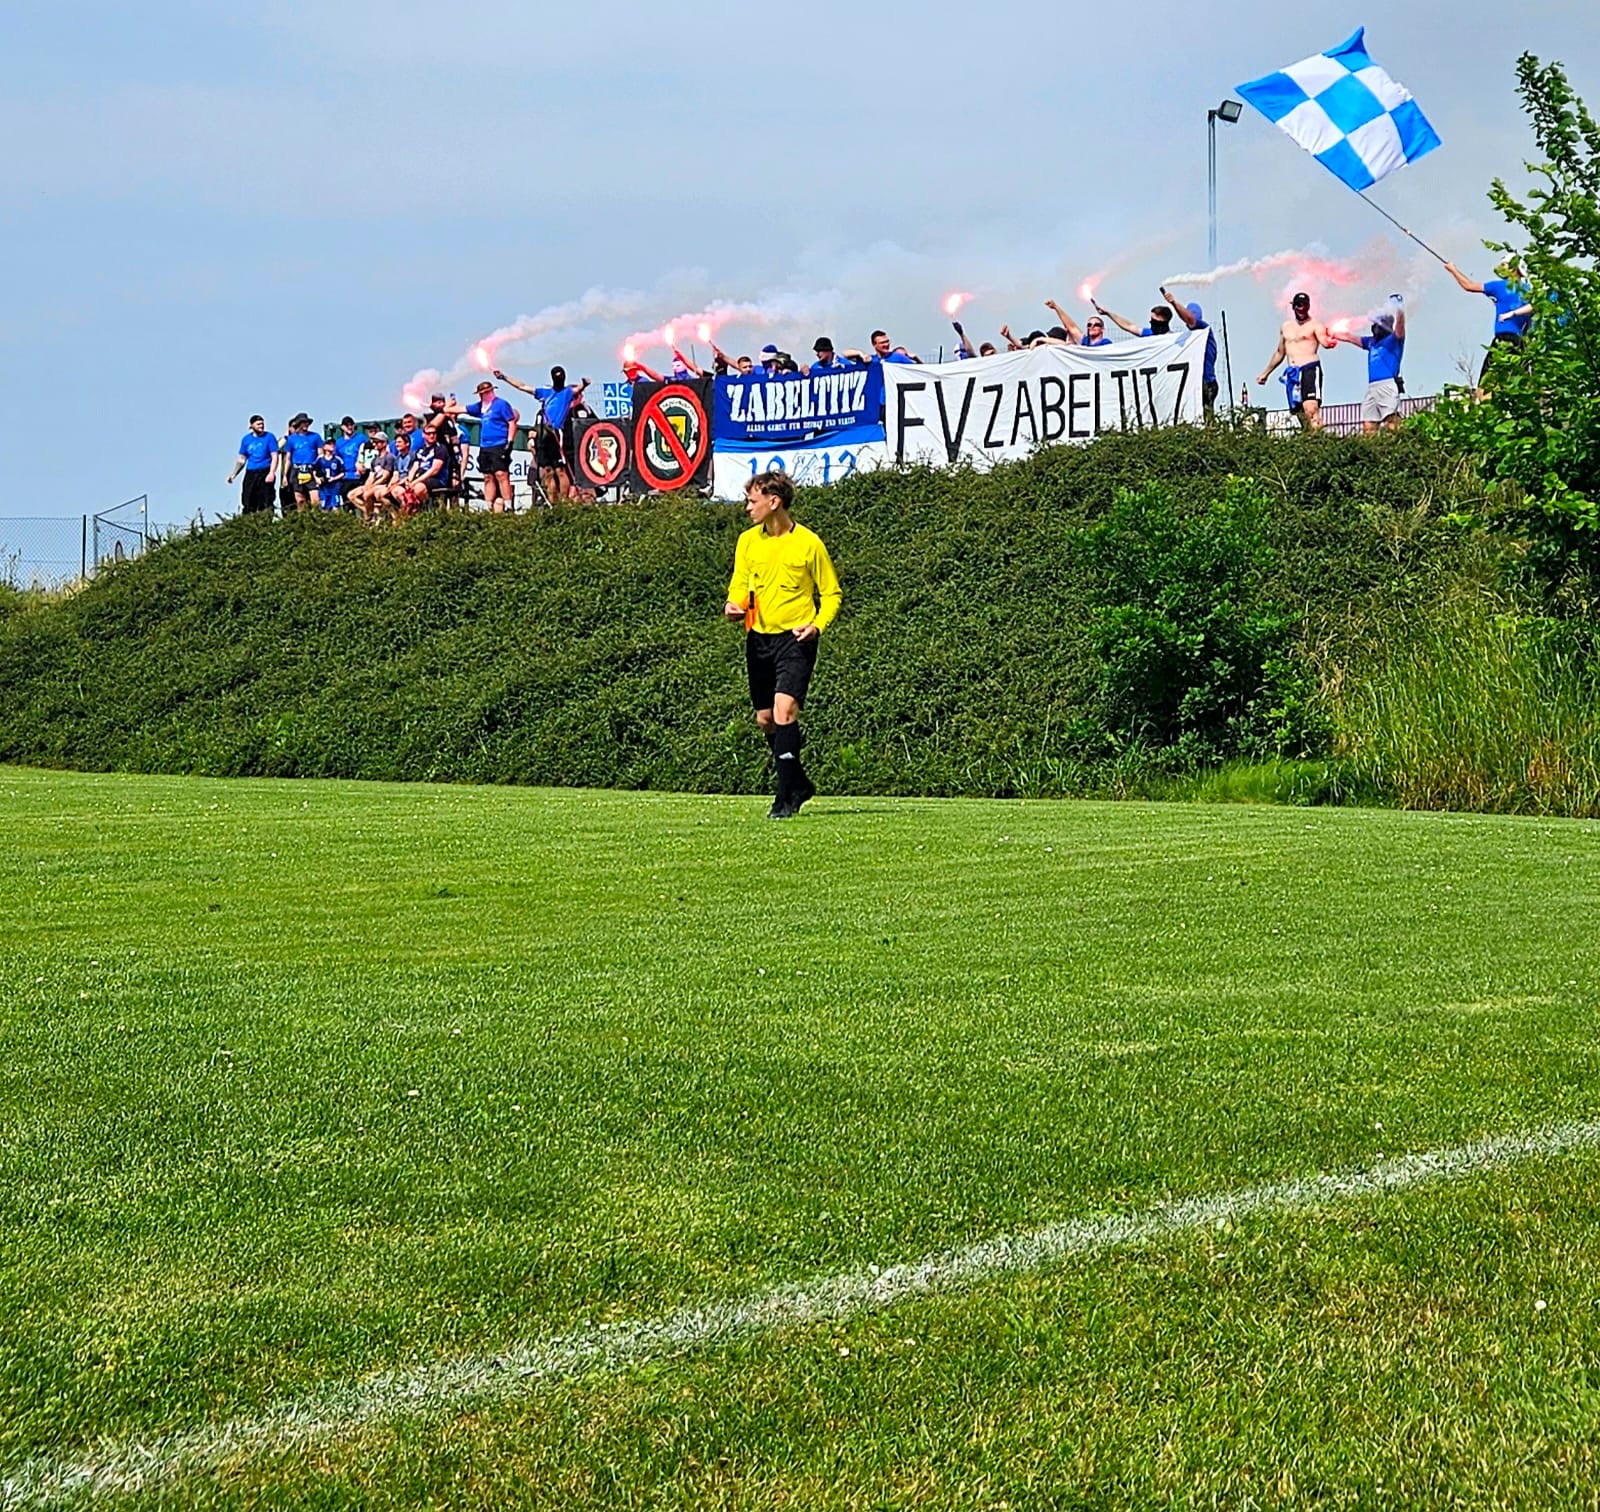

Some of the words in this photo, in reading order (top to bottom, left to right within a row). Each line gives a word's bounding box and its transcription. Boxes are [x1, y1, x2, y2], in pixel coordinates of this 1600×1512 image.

[605, 384, 629, 396] AC
[727, 371, 868, 422] ZABELTITZ
[606, 401, 630, 415] AB
[896, 376, 977, 464] FV
[982, 362, 1190, 448] ZABELTITZ
